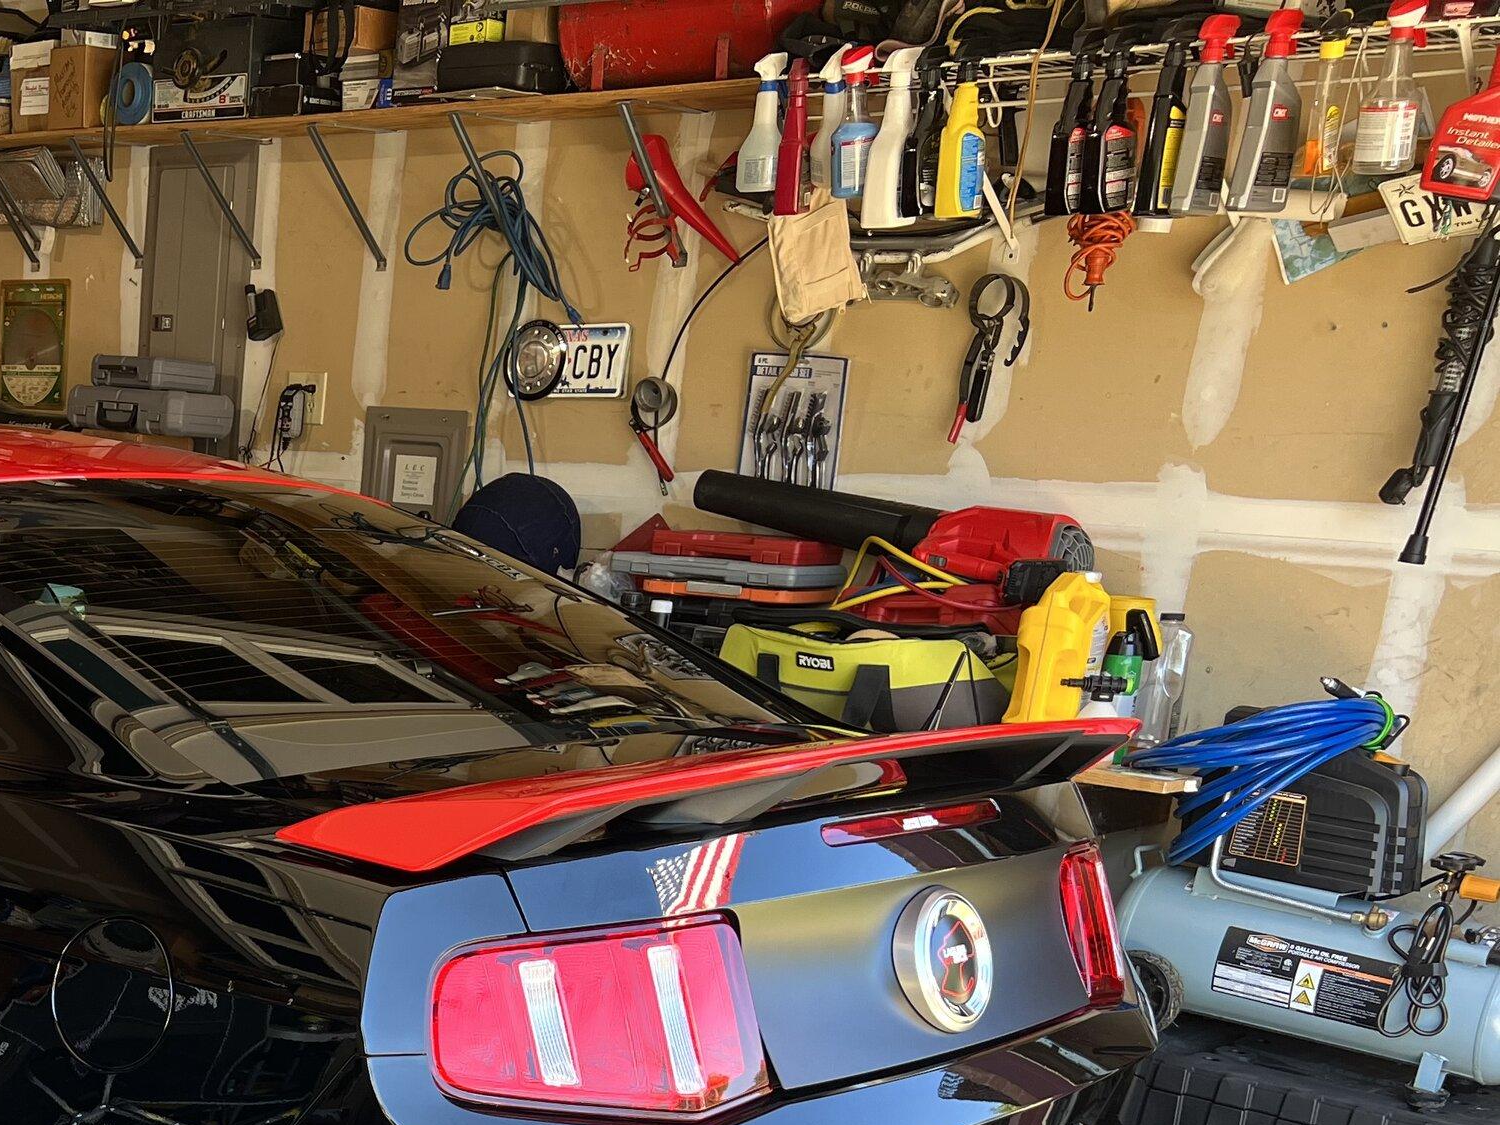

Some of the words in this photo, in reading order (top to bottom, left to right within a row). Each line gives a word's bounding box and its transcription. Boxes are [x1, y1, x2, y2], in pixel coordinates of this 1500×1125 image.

[181, 109, 216, 119] CRAFTSMAN
[1447, 127, 1490, 140] Instant
[572, 343, 619, 379] CBY
[756, 366, 778, 376] DETAIL
[798, 654, 833, 670] RYOBI
[1248, 936, 1288, 951] McGRAW
[1294, 945, 1319, 956] GALLON
[1331, 953, 1348, 962] FREE
